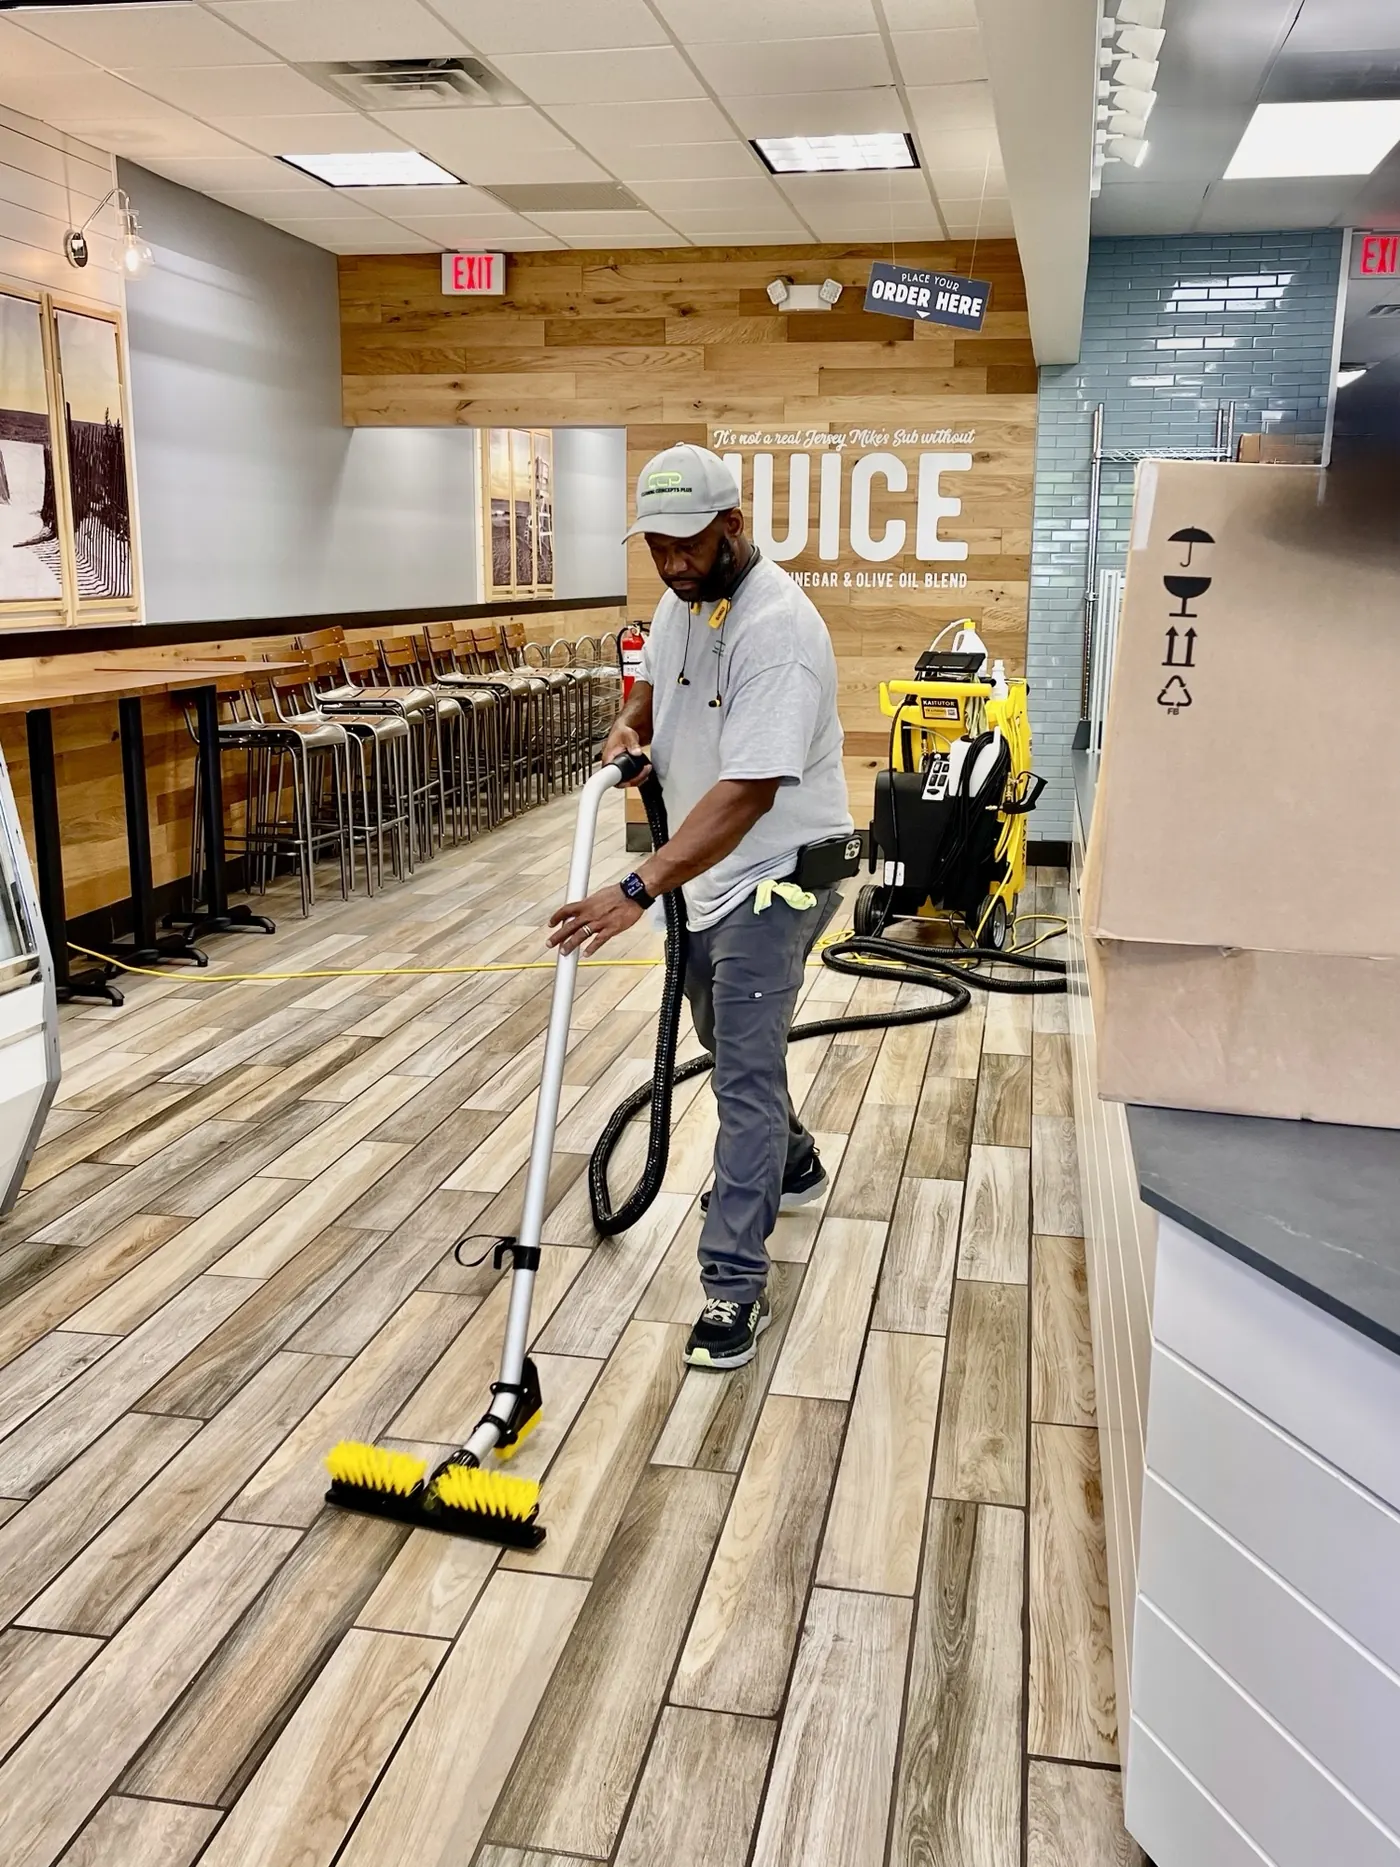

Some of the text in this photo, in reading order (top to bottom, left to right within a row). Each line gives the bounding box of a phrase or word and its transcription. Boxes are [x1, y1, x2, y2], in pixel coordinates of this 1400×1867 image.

[1361, 236, 1399, 274] EXI
[453, 256, 494, 290] EXIT
[901, 273, 960, 292] PLACE YOUR
[871, 279, 983, 318] ORDER HERE
[713, 428, 976, 452] It's not a real Jersey Mike's Sub without
[786, 572, 968, 589] INEGAR & OLIVE OIL BLEND
[1167, 708, 1180, 716] FB
